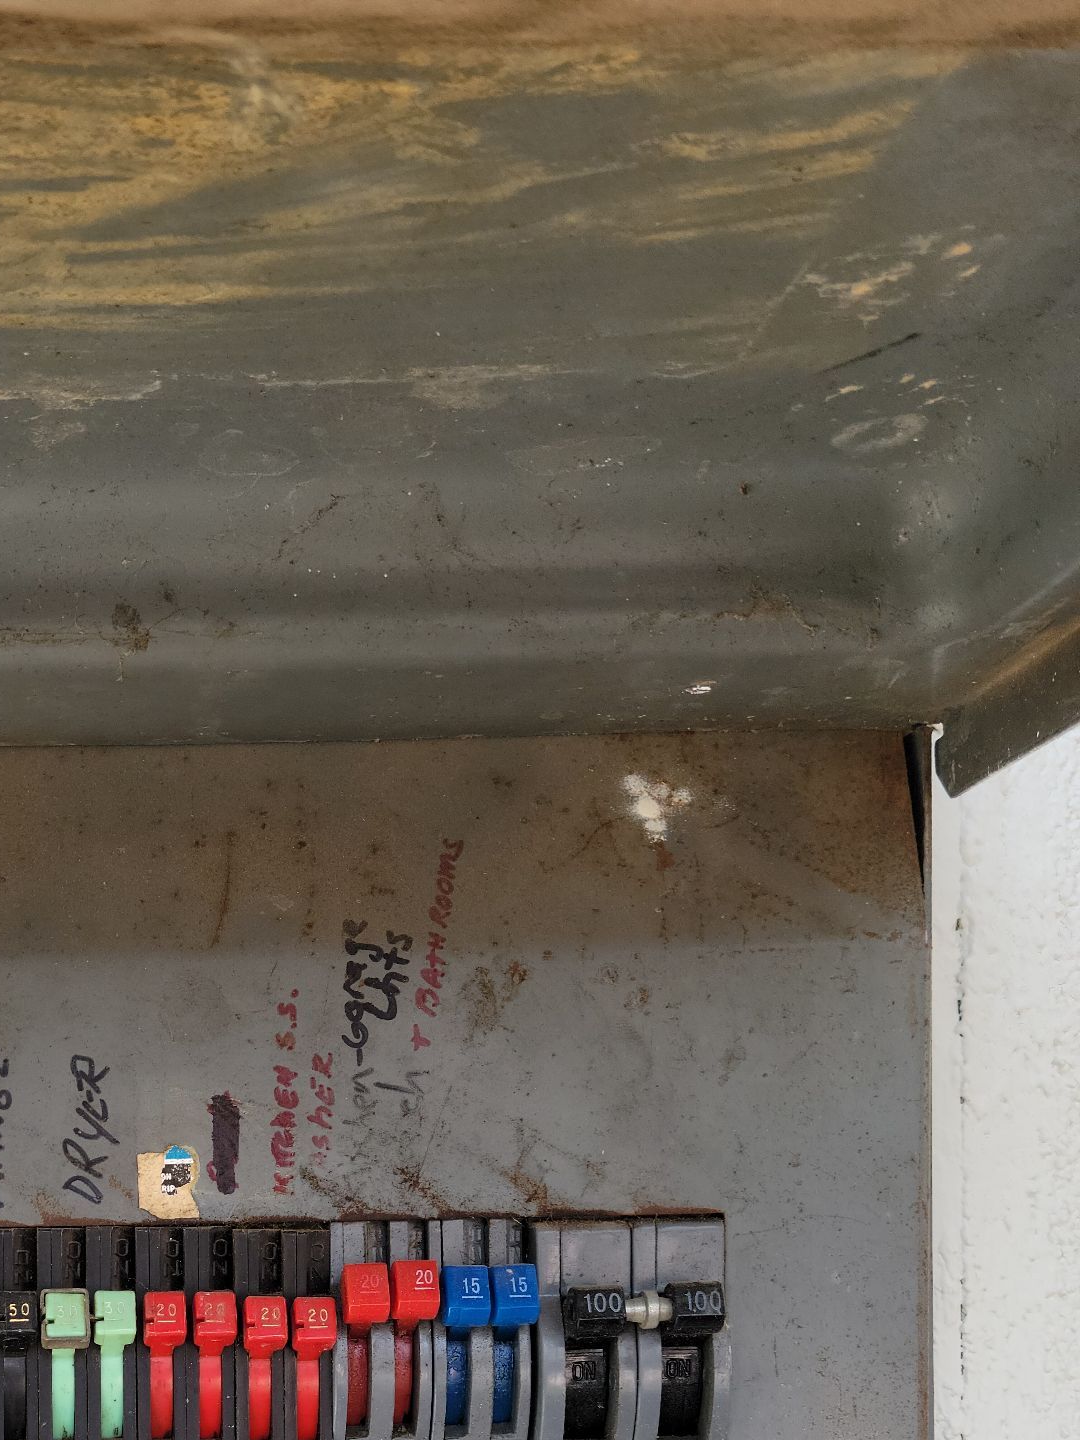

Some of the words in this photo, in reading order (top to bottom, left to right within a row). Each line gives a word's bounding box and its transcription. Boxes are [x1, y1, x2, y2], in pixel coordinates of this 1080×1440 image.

[415, 1269, 433, 1285] 20
[463, 1277, 480, 1293] 15
[510, 1276, 527, 1292] 15
[583, 1292, 622, 1312] 100
[684, 1290, 721, 1311] 100
[9, 1302, 30, 1316] 50
[156, 1303, 176, 1316] 20
[261, 1307, 280, 1320] 20
[308, 1308, 328, 1322] 20
[572, 1361, 596, 1381] ON
[666, 1360, 691, 1377] ON
